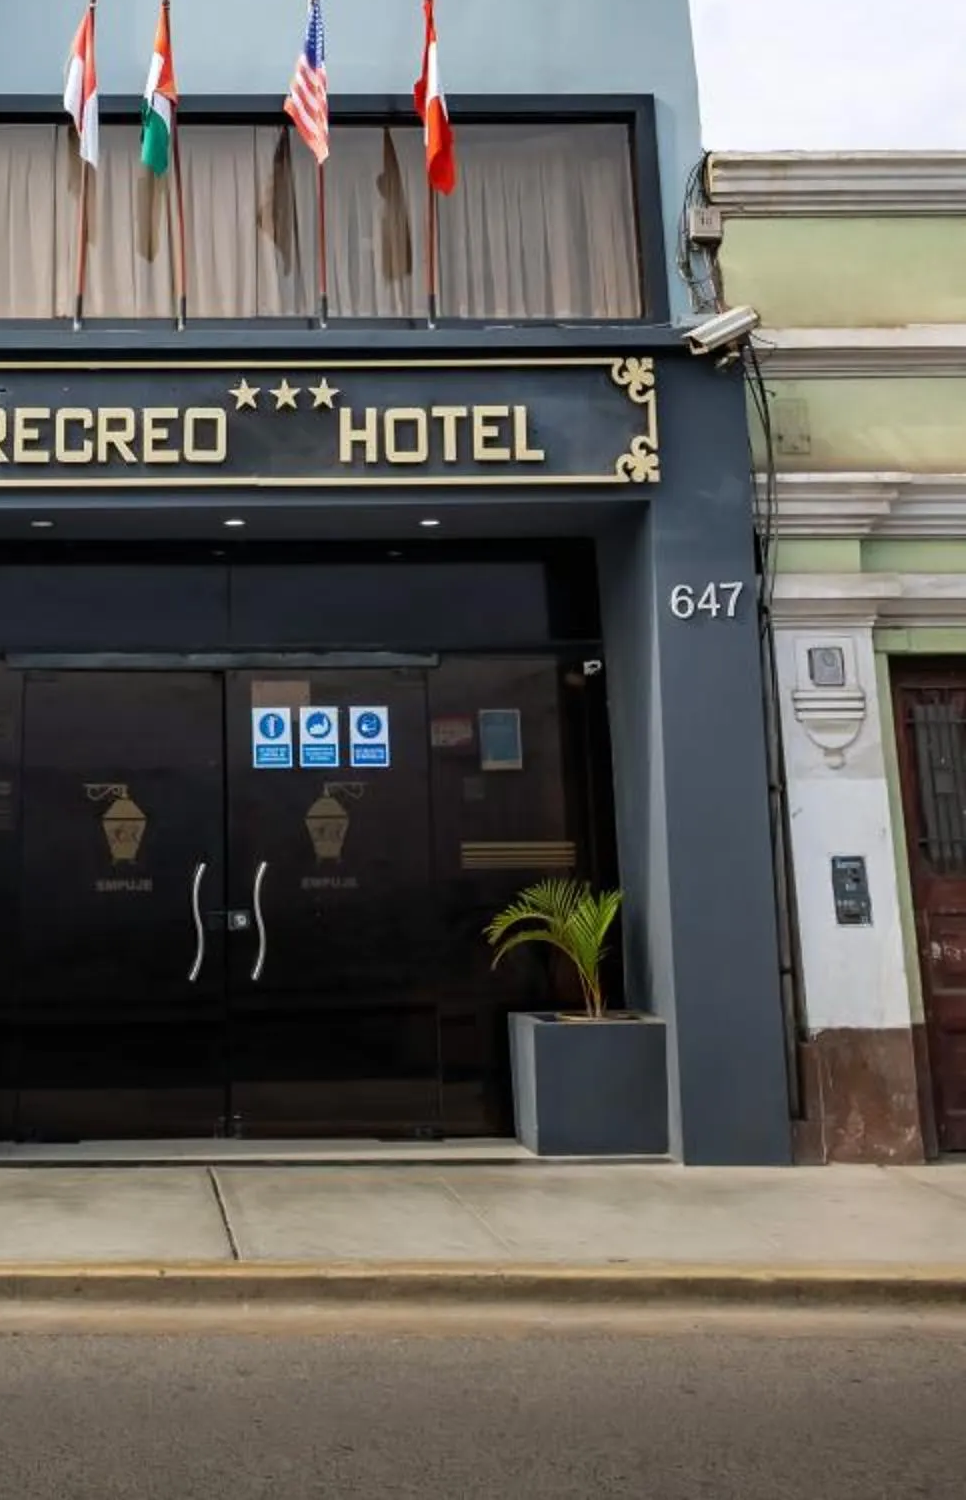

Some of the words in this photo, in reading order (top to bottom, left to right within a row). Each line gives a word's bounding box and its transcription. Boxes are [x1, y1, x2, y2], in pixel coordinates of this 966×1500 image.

[338, 404, 545, 463] HOTEL
[671, 581, 743, 618] 647
[94, 878, 153, 892] EMPUJE
